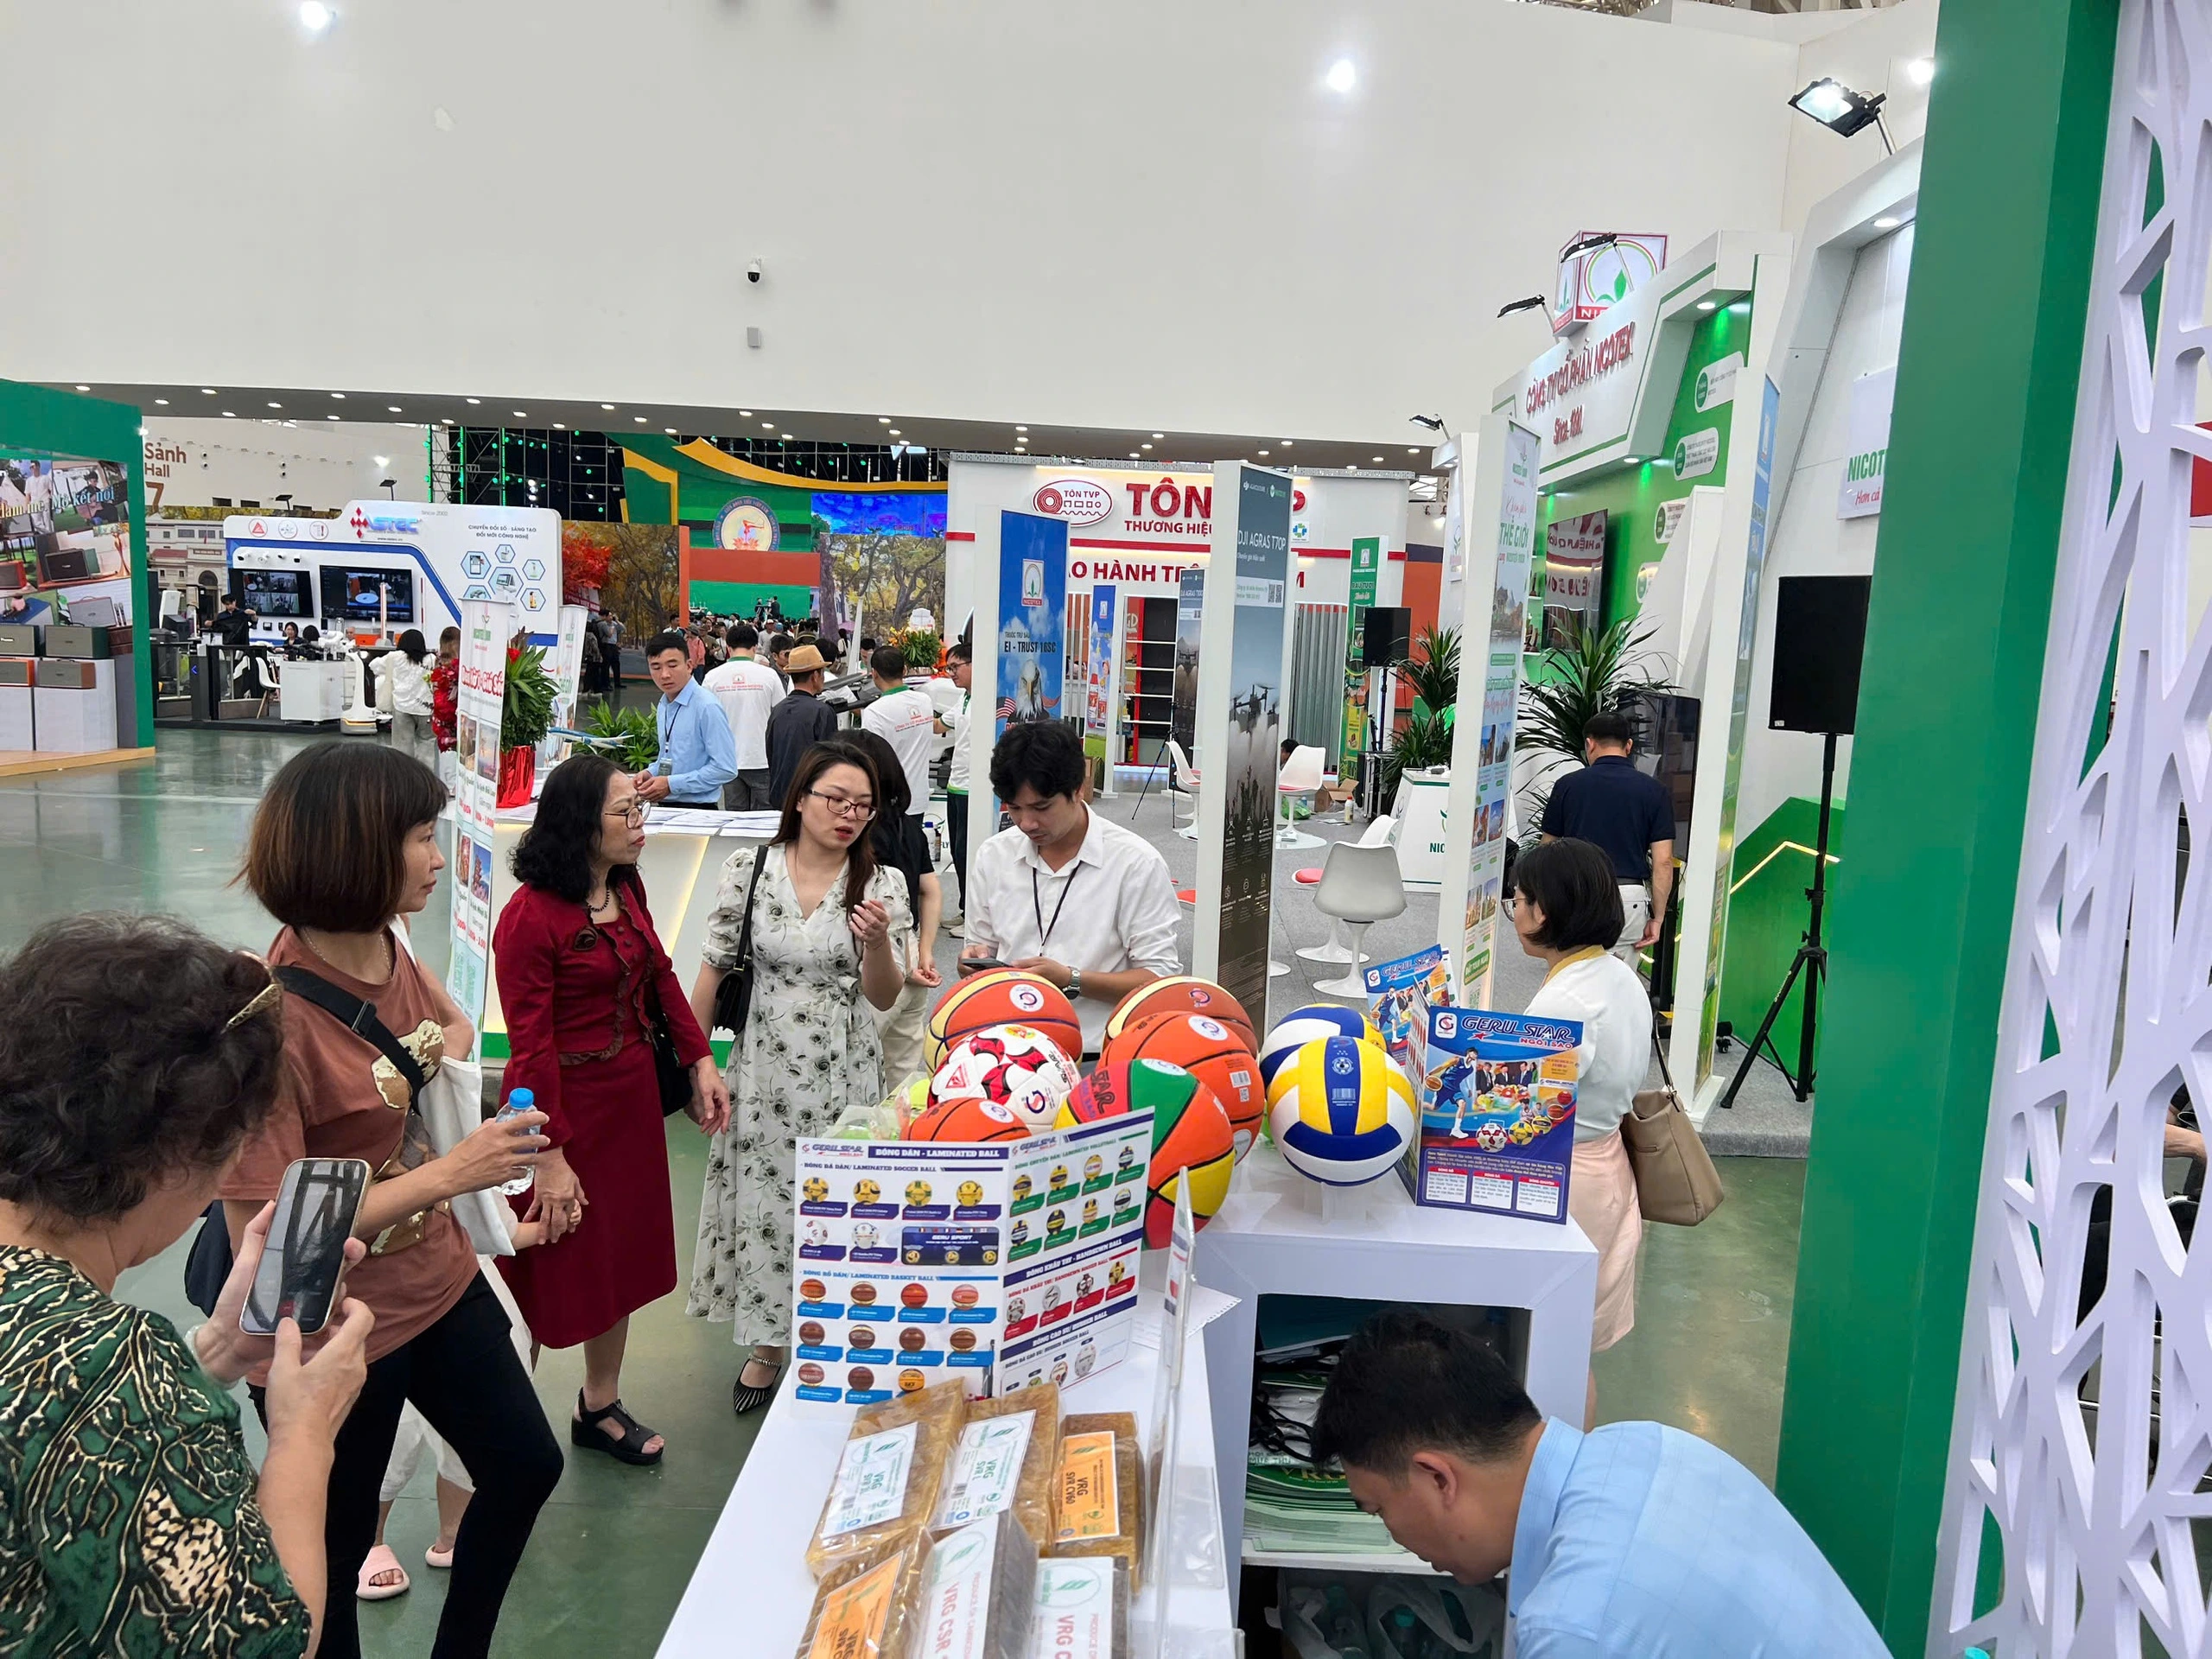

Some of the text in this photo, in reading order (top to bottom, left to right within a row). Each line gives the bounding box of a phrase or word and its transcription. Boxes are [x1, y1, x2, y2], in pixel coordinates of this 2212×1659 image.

[1593, 321, 1635, 375] NICOTEX
[144, 442, 187, 463] Sảnh
[144, 462, 169, 477] Hall
[145, 481, 164, 513] 7
[1064, 488, 1101, 499] TÔN TVP
[1126, 477, 1211, 518] TÔN
[1124, 520, 1184, 534] THƯƠNG
[1237, 531, 1287, 551] DJI AGRAS T70P
[1094, 560, 1160, 582] HÀNH
[1018, 641, 1039, 653] TRUST
[1461, 1015, 1575, 1044] GERU STAR
[1520, 1038, 1548, 1046] NGÔI
[875, 1147, 899, 1157] BÓNG
[902, 1147, 920, 1157] DÁN
[926, 1149, 977, 1158] LAMINATED
[1063, 1146, 1090, 1157] LAMINATED
[1027, 1267, 1044, 1279] BÓNG
[1109, 1238, 1122, 1250] BALL
[1098, 1258, 1109, 1267] BALL
[1033, 1336, 1050, 1347] BÓNG
[1050, 1331, 1062, 1340] CAO
[1094, 1311, 1108, 1322] BALL
[1078, 1329, 1090, 1338] BALL
[975, 1460, 987, 1476] SVR
[983, 1459, 998, 1479] VRG
[873, 1471, 886, 1491] VRG
[1065, 1471, 1076, 1504] SVR CV60
[1077, 1476, 1089, 1497] VRG
[935, 1581, 960, 1654] VRG CSR
[1056, 1614, 1075, 1646] VRG
